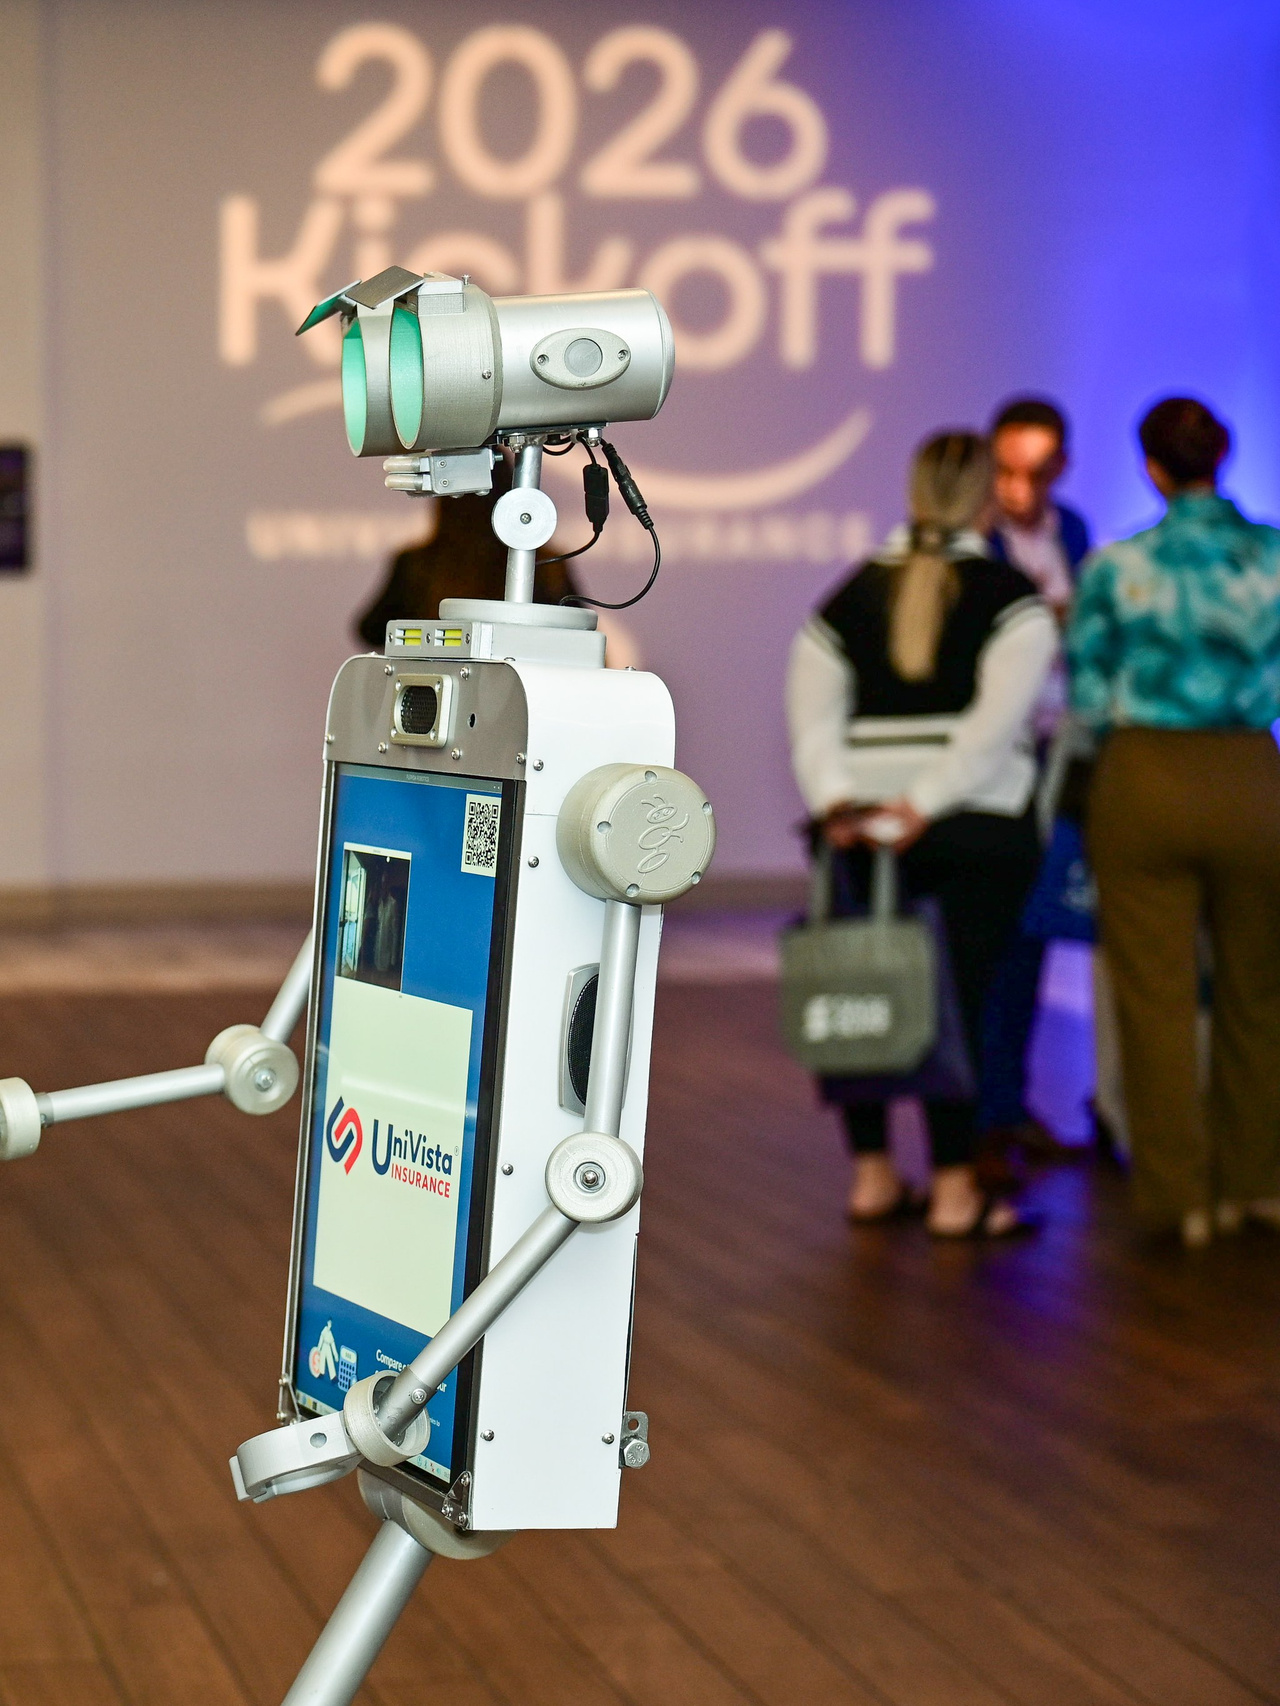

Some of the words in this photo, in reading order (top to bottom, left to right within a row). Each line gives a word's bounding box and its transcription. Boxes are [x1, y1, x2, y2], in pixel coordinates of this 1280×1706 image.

[315, 22, 828, 198] 2026
[371, 1119, 453, 1176] UniVista
[391, 1163, 451, 1198] INSURANCE
[376, 1349, 402, 1371] Compare
